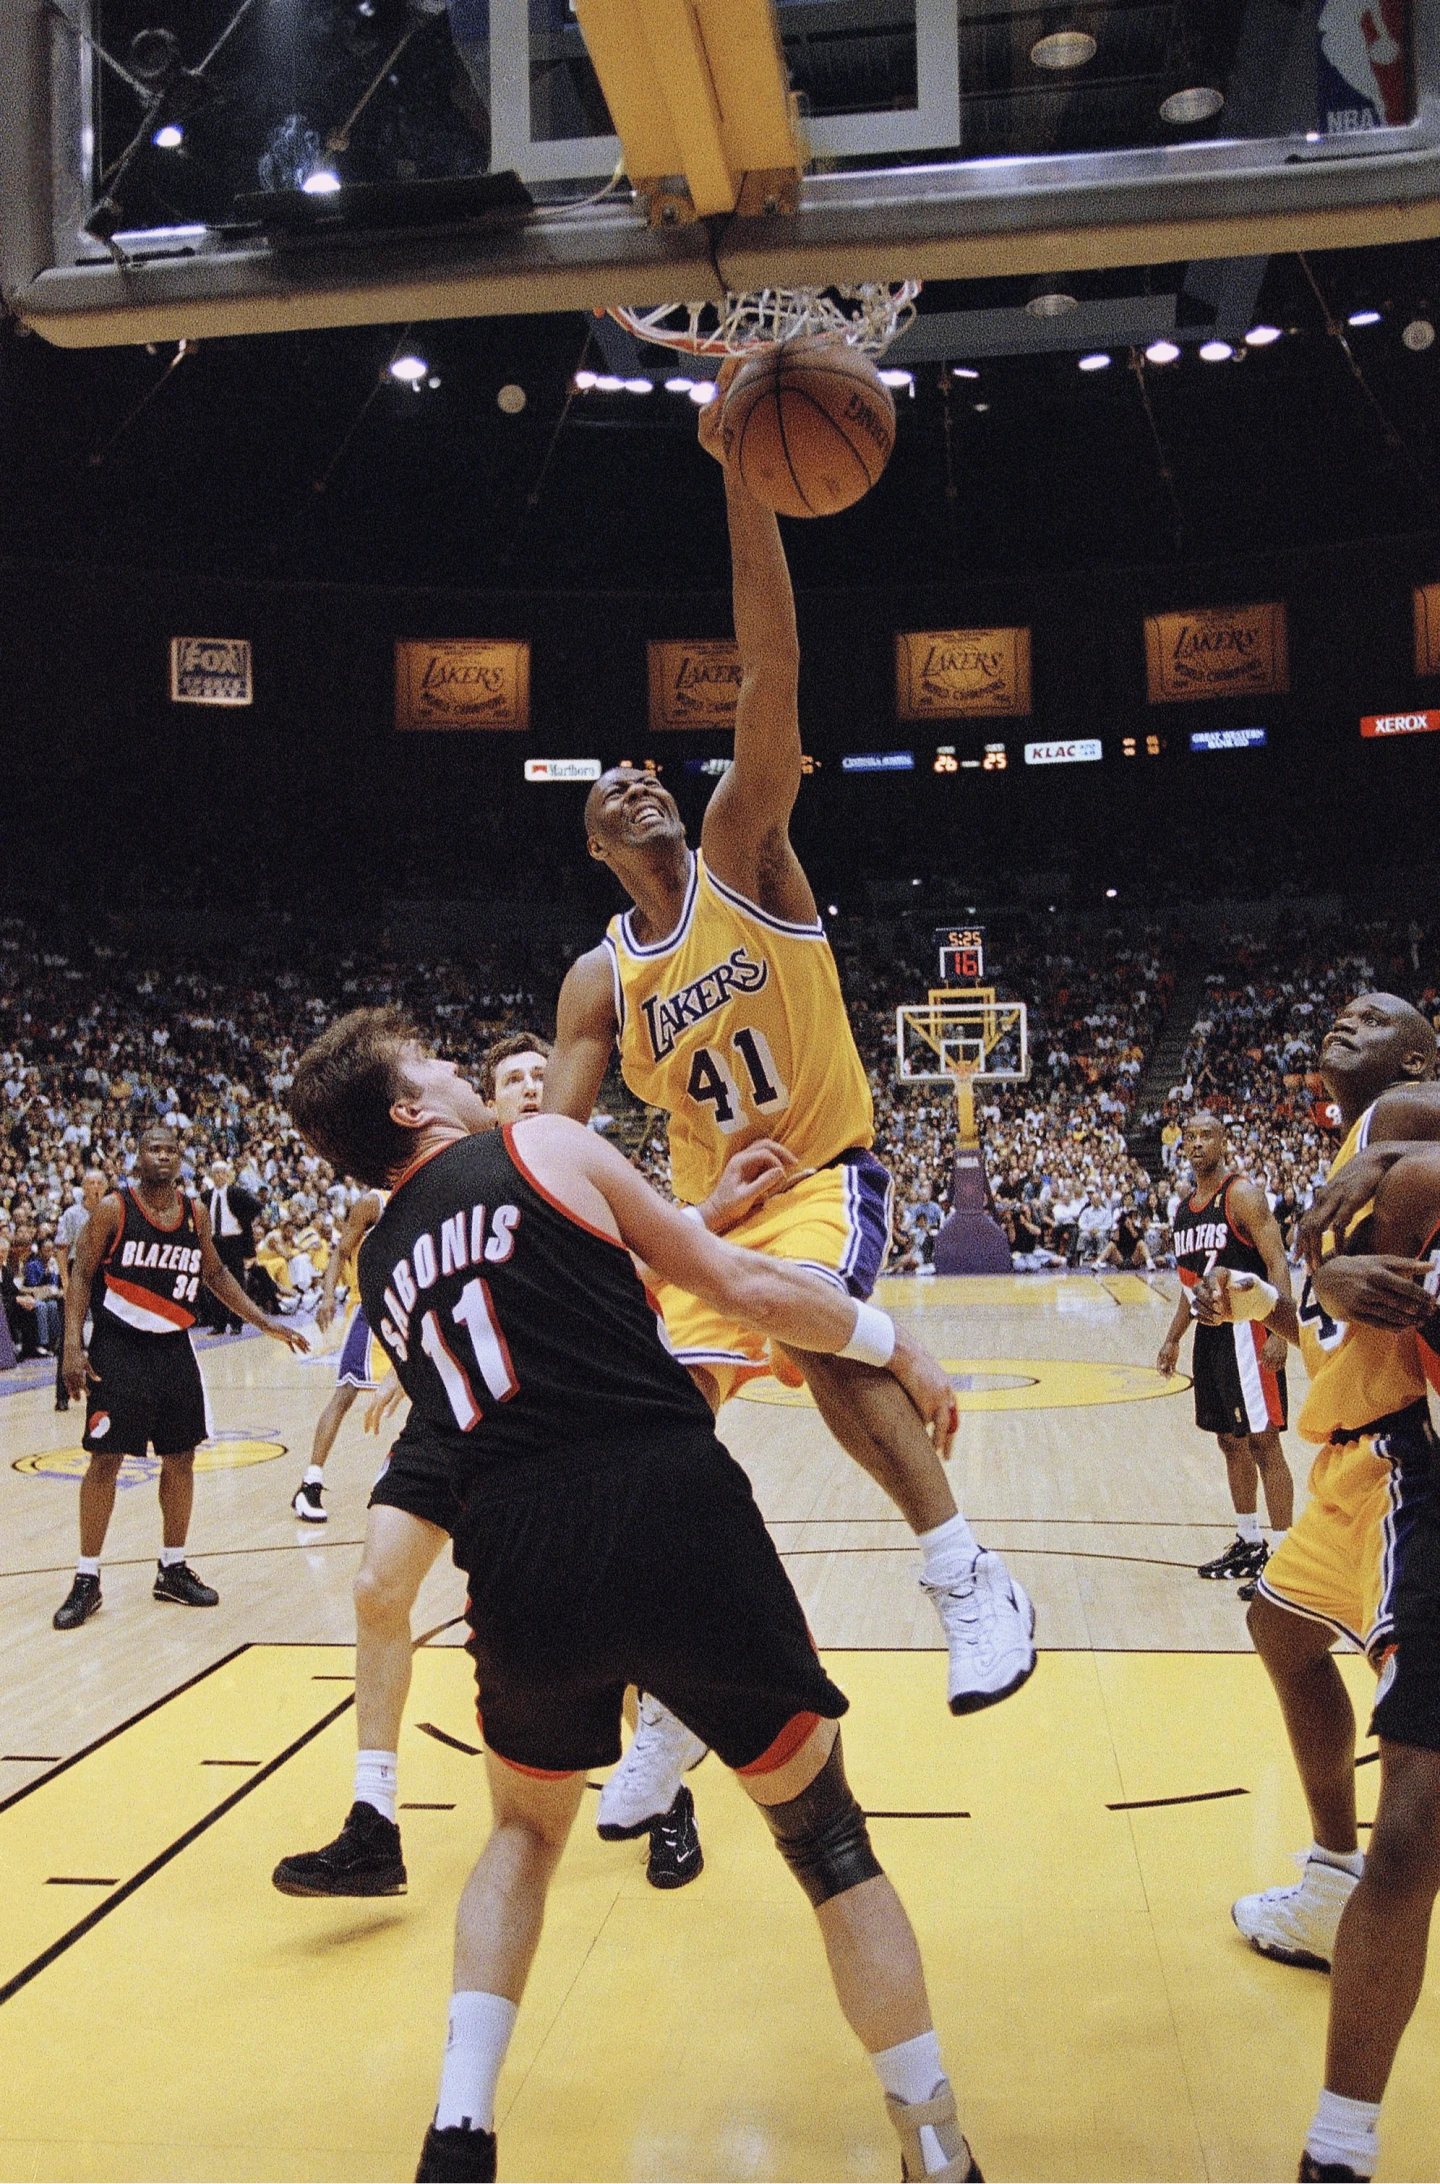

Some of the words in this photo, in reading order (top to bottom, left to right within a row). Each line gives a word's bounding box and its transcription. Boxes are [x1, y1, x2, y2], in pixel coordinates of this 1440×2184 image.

[1326, 107, 1376, 135] NBA
[1173, 626, 1259, 656] LAKERS
[182, 643, 240, 674] FOX
[673, 656, 744, 689] LAKER
[921, 645, 1004, 678] LAKERS
[420, 656, 505, 693] LAKERS
[1374, 714, 1428, 734] XEROX
[933, 753, 959, 774] 26
[982, 751, 1008, 771] 25
[1032, 744, 1077, 760] KLAC
[549, 763, 595, 777] Marlboro
[948, 930, 982, 947] 5:25
[954, 949, 978, 977] 16
[640, 946, 769, 1064] LAKERS
[686, 1027, 787, 1132] 41
[121, 1240, 202, 1274] BLAZERS
[1203, 1250, 1218, 1277] 7
[172, 1273, 200, 1303] 34
[380, 1203, 522, 1362] SABONIS
[420, 1276, 521, 1433] 11
